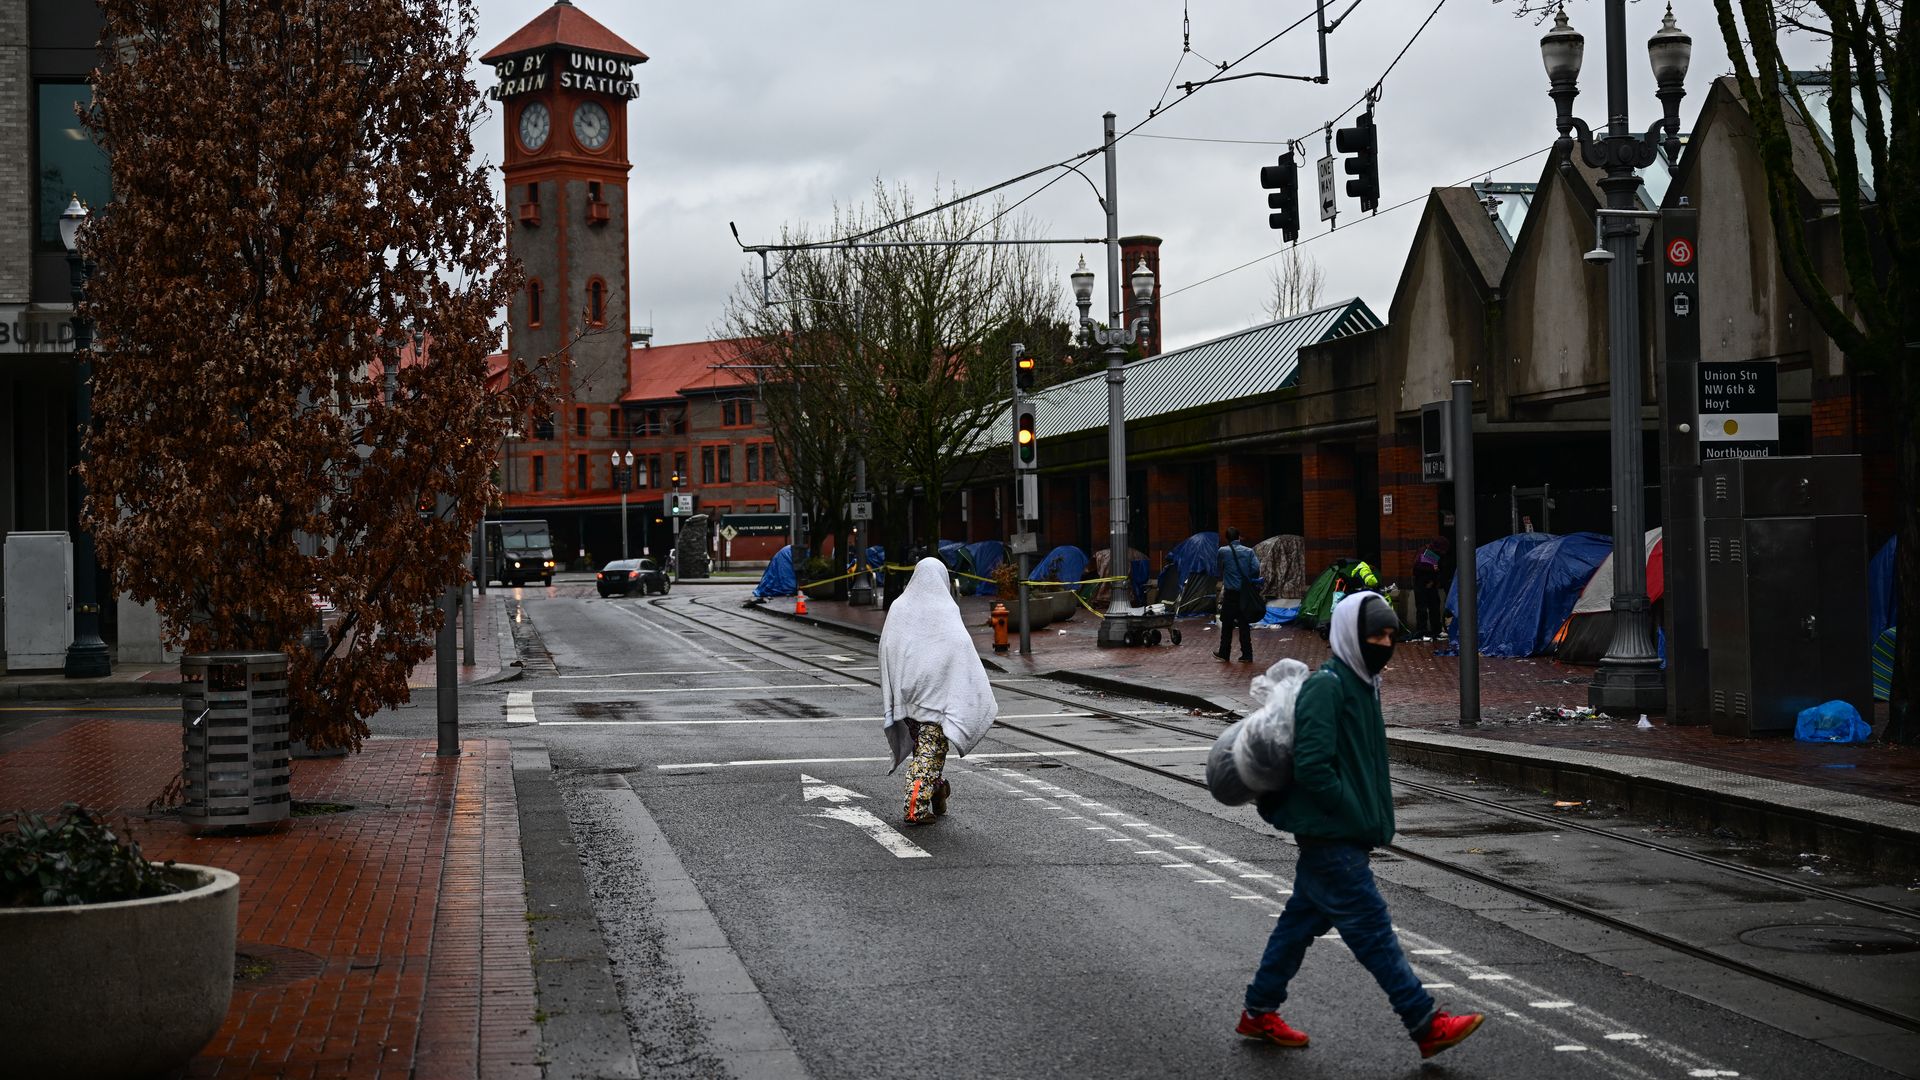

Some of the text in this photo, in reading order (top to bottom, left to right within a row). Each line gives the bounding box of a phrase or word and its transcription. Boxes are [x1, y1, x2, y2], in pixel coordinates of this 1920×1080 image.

[495, 53, 546, 77] GO BY
[571, 53, 631, 77] UNION
[496, 73, 546, 99] TRAIN
[561, 71, 640, 98] STATION
[1320, 161, 1331, 177] ONE
[1321, 177, 1333, 194] WAY
[1666, 272, 1695, 284] MAX
[0, 321, 82, 345] BUILD
[1704, 370, 1758, 381] Union Stn
[1704, 384, 1756, 394] NW 6th &
[1705, 399, 1730, 411] Hoyt
[1706, 447, 1769, 459] Northbound
